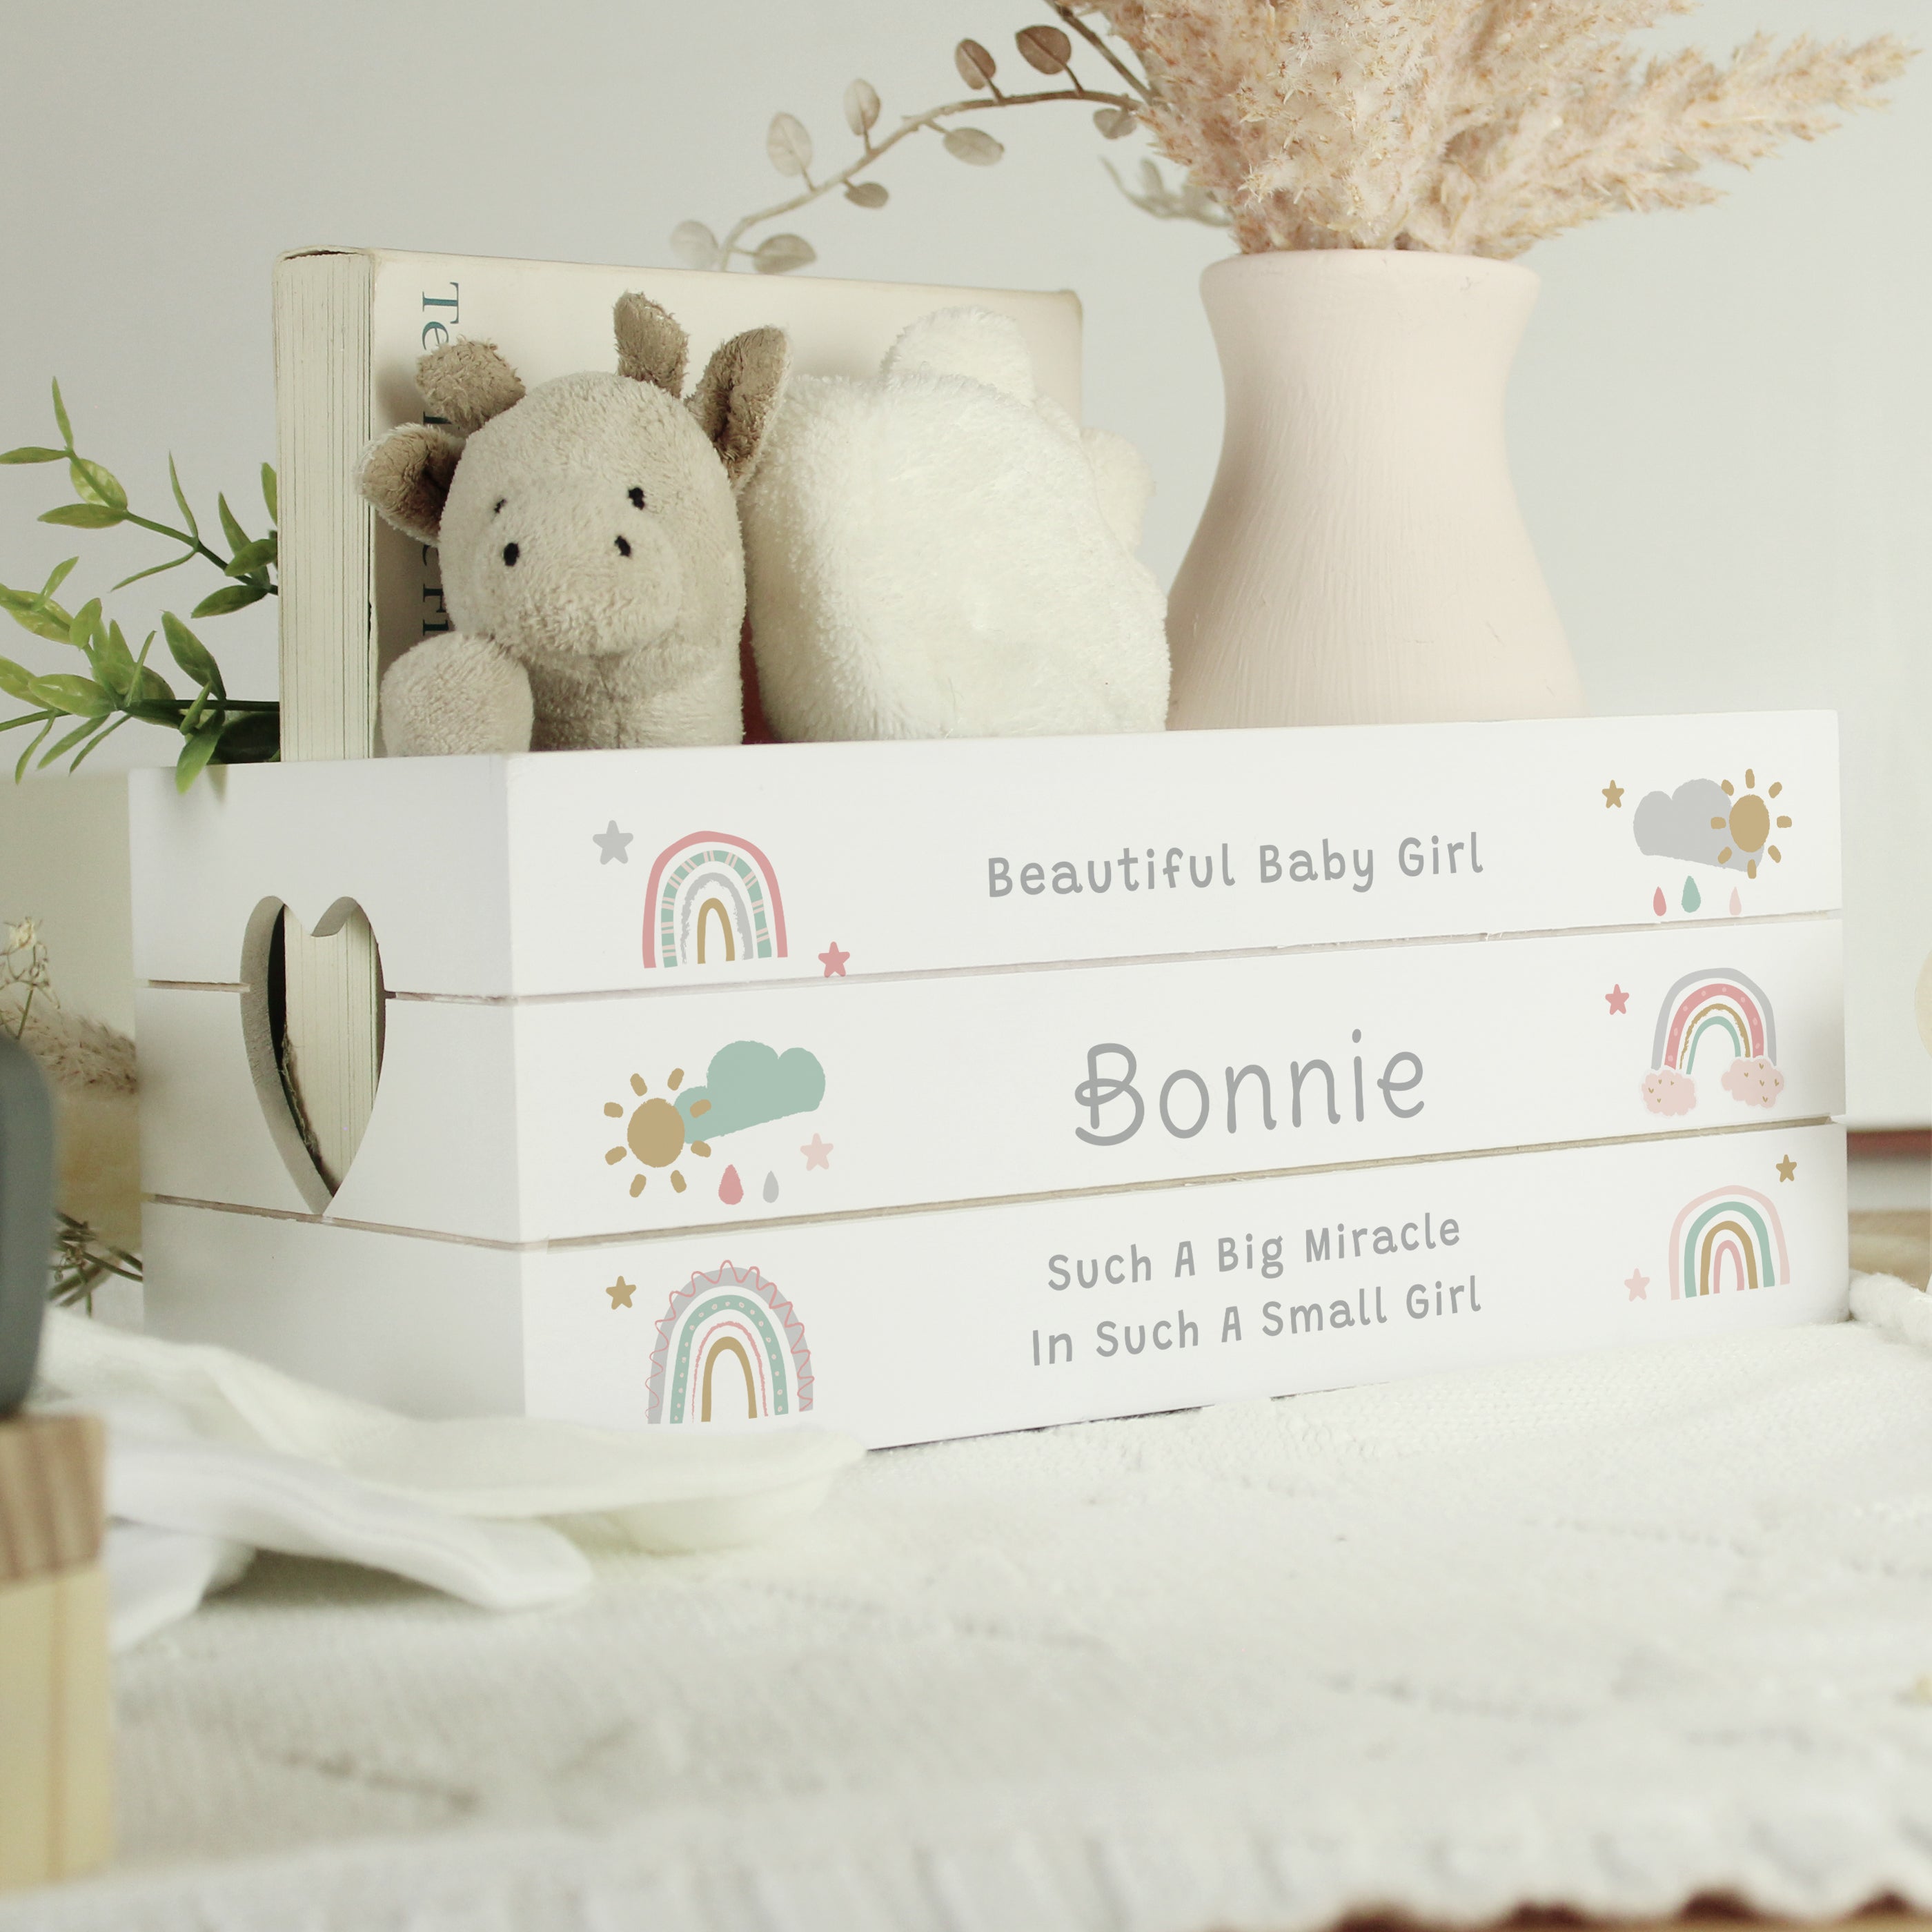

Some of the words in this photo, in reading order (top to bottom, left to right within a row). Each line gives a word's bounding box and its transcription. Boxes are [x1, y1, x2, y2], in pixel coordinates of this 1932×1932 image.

[988, 842, 1236, 898] Beautiful
[1259, 838, 1374, 893] Baby
[1398, 831, 1483, 877] Girl
[1074, 1028, 1425, 1147] Bonnie
[1048, 1243, 1152, 1291] Such
[1174, 1241, 1196, 1278] A
[1218, 1233, 1284, 1279] Big
[1305, 1212, 1460, 1263] Miracle
[1032, 1330, 1073, 1366] In
[1096, 1309, 1199, 1357] Such
[1221, 1305, 1242, 1343] A
[1262, 1286, 1388, 1337] Small
[1406, 1274, 1481, 1319] Girl
